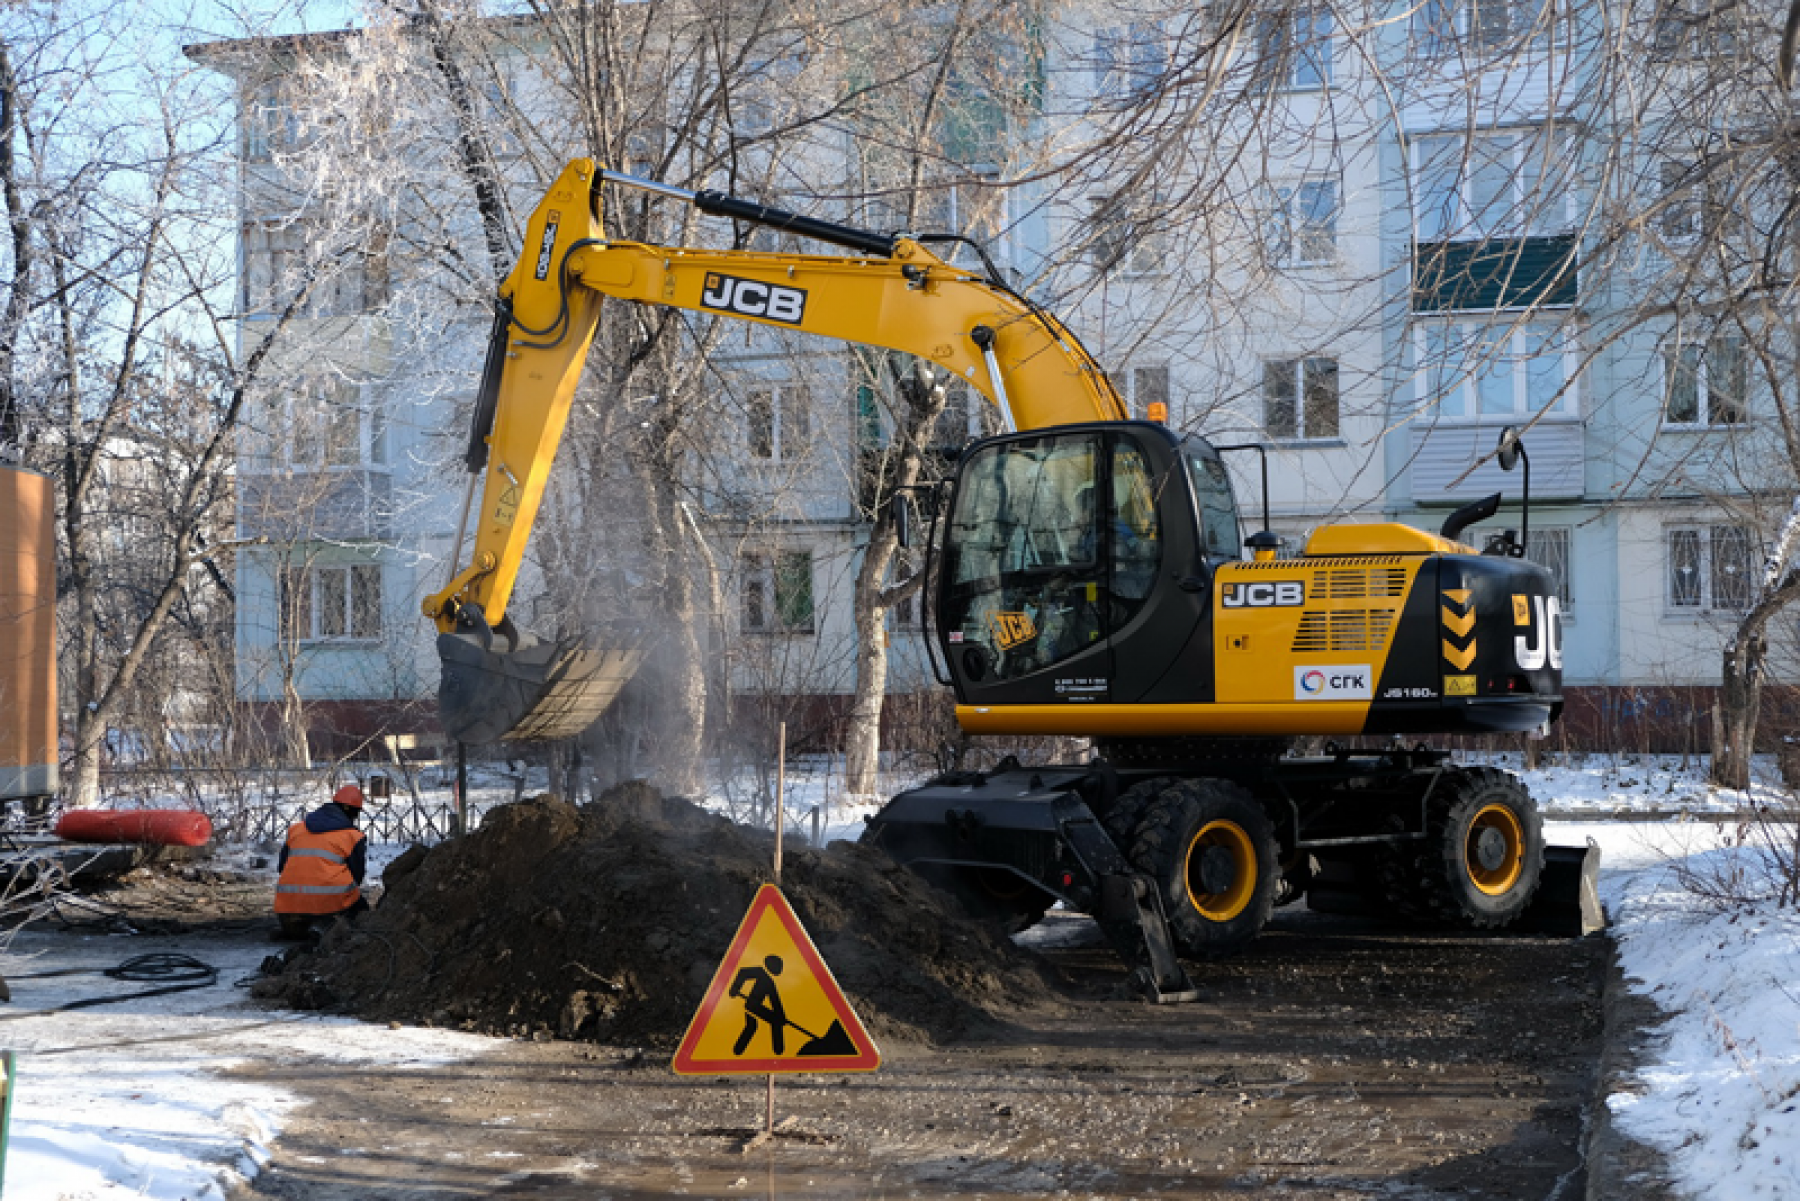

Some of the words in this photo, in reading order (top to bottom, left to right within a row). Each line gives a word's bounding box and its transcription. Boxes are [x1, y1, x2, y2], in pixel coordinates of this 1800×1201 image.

[537, 224, 557, 278] JCB
[704, 278, 803, 322] JCB
[1224, 582, 1303, 605] JCB
[993, 615, 1032, 643] JCB
[1330, 674, 1365, 689] СГК
